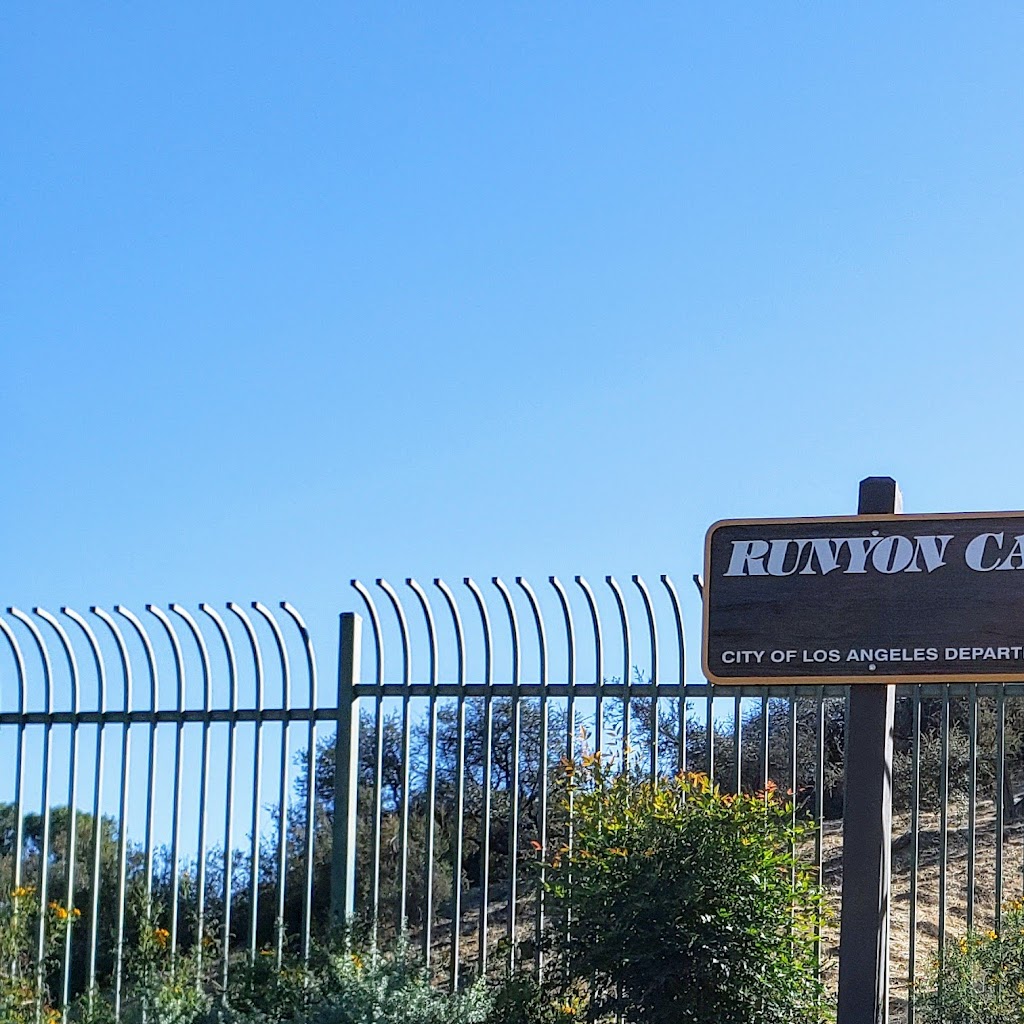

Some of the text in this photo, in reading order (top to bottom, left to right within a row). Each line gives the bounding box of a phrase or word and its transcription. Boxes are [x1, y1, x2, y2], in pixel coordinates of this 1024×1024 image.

[722, 535, 954, 577] RUNYON
[721, 650, 765, 664] CITY
[770, 650, 797, 663] OF
[803, 649, 840, 662] LOS
[846, 648, 938, 662] ANGELES
